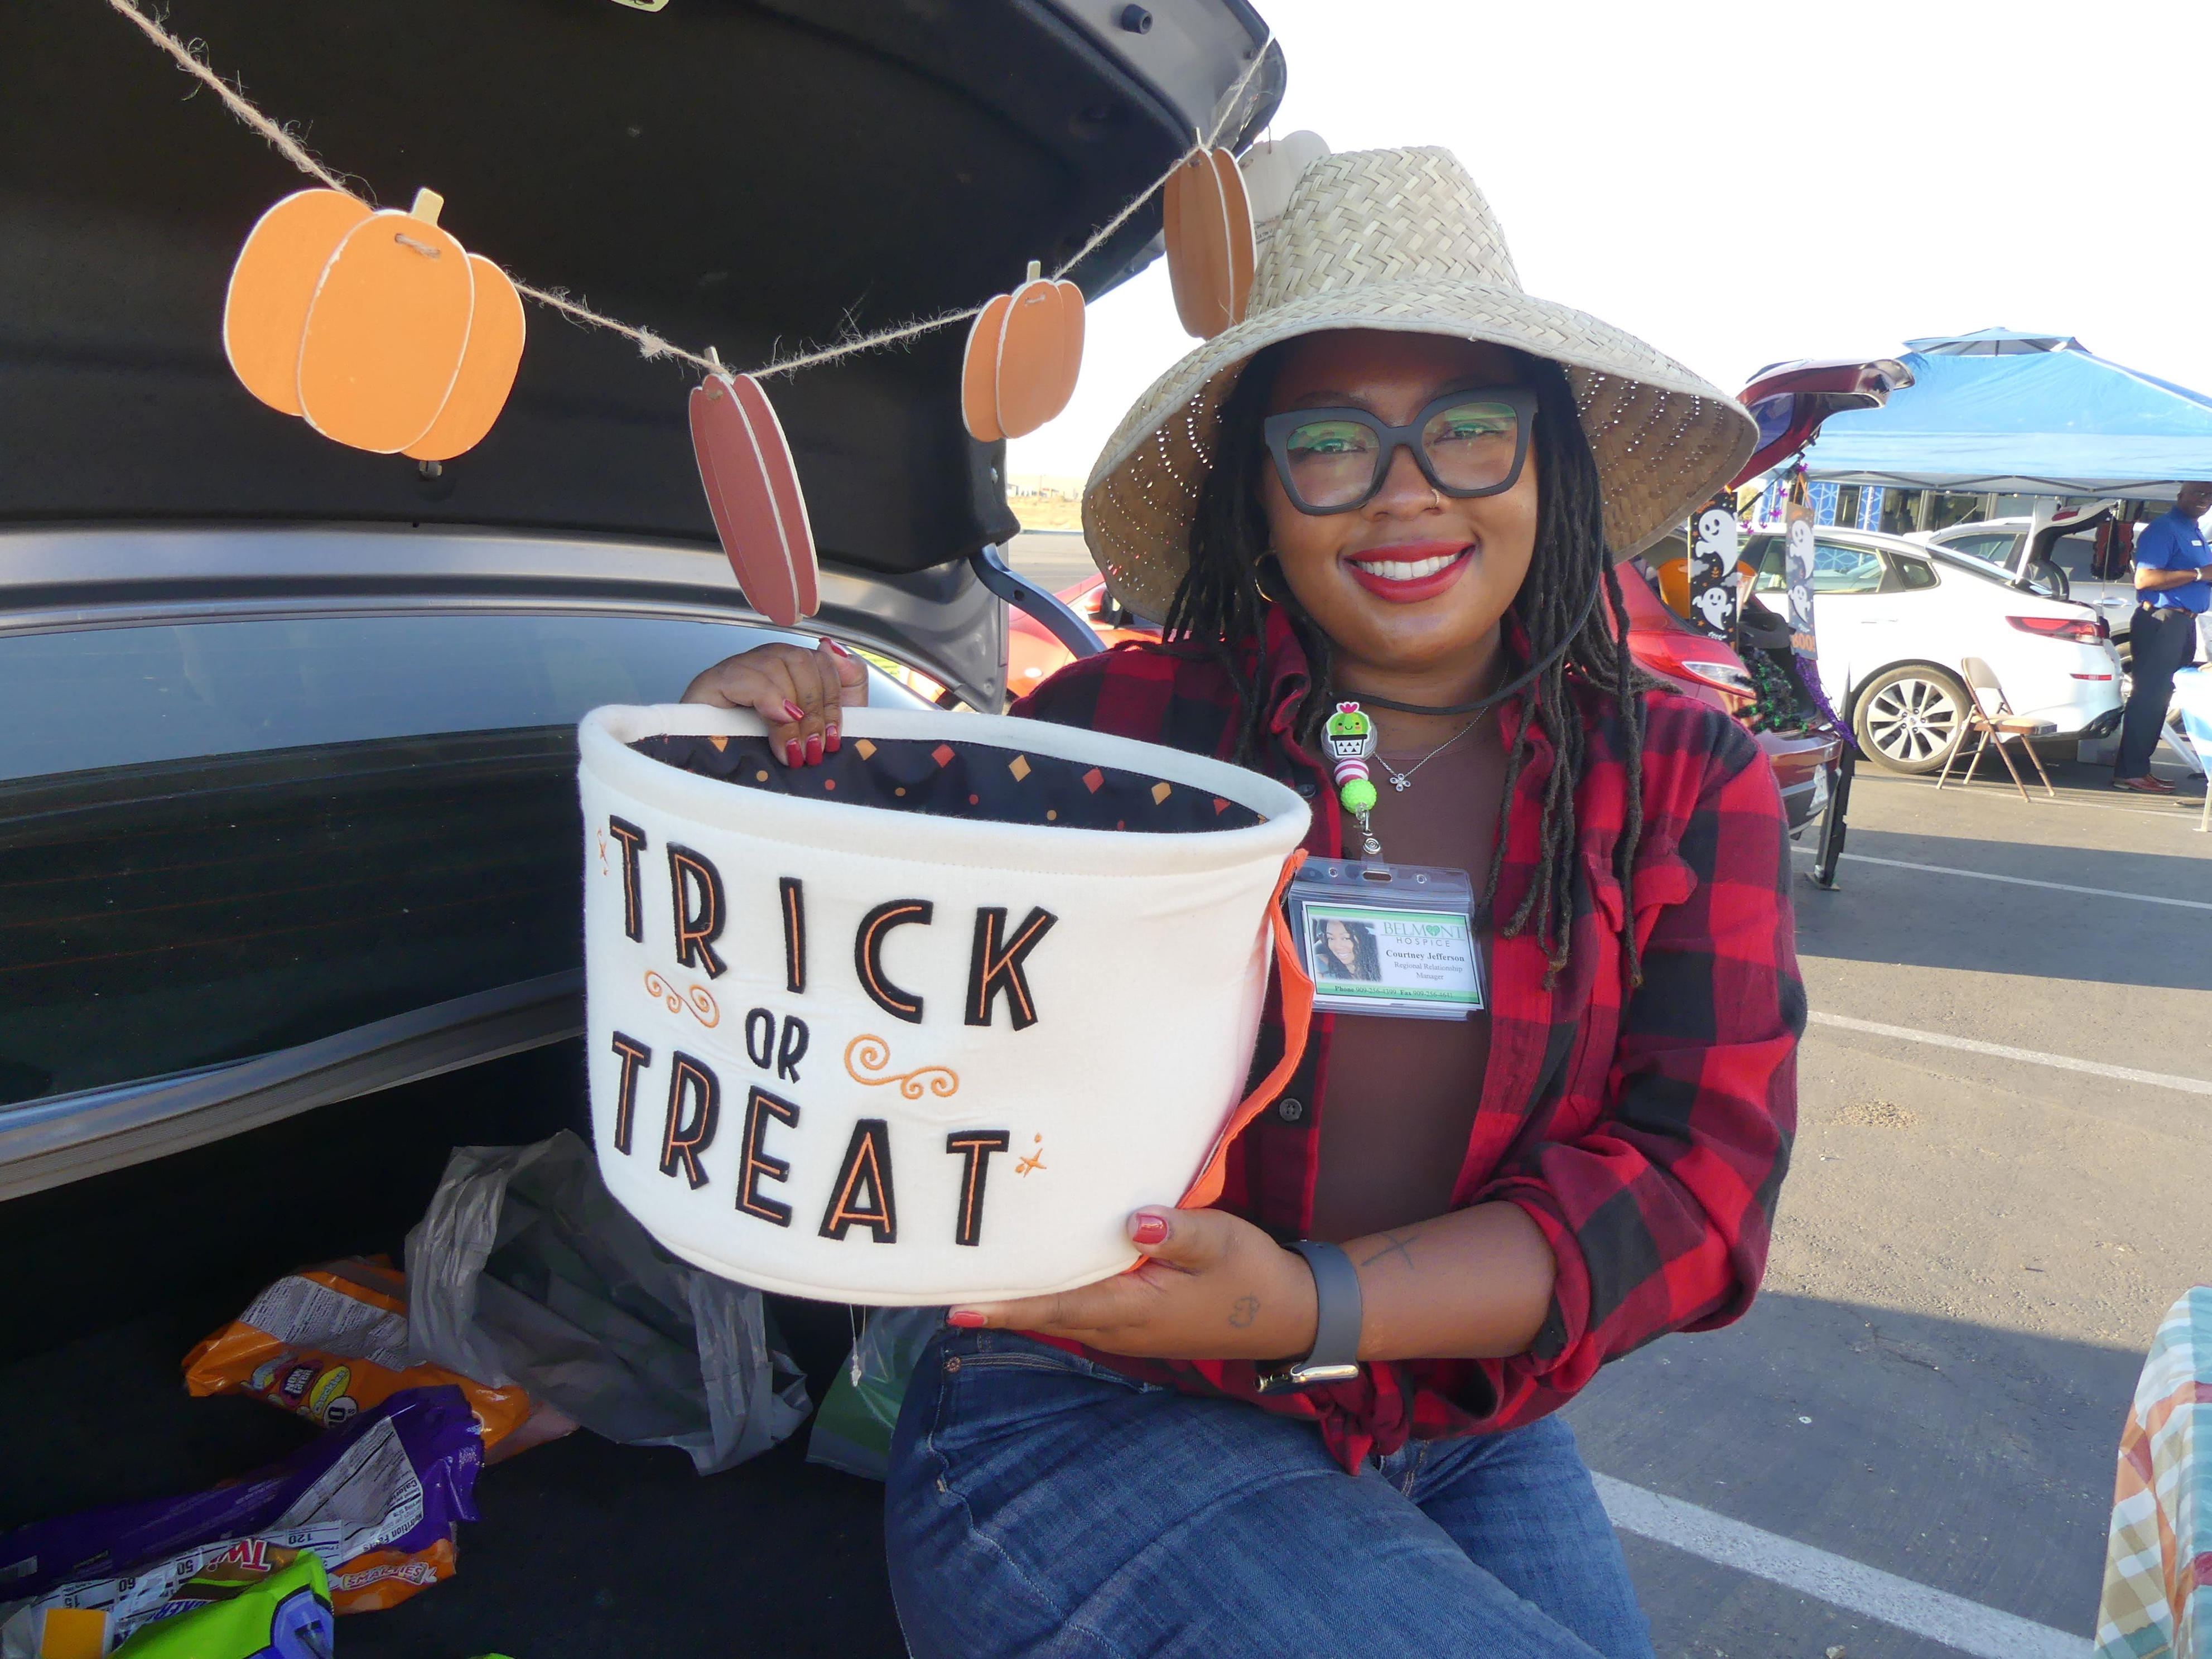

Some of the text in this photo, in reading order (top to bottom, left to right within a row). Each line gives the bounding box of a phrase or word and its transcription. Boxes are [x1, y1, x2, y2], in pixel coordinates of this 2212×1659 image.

[609, 815, 1058, 1031] TRICK
[1396, 937, 1450, 947] HOSPICE
[1386, 949, 1464, 962] Courtney Jefferson
[1394, 961, 1463, 972] Regional Relationship
[1416, 972, 1444, 981] Manager
[745, 1007, 809, 1083] OR
[612, 1030, 1010, 1247] TREAT
[288, 1533, 313, 1545] 120
[207, 1539, 271, 1573] Twi
[177, 1560, 194, 1576] 50
[119, 1577, 136, 1593] 60
[64, 1594, 80, 1609] 15
